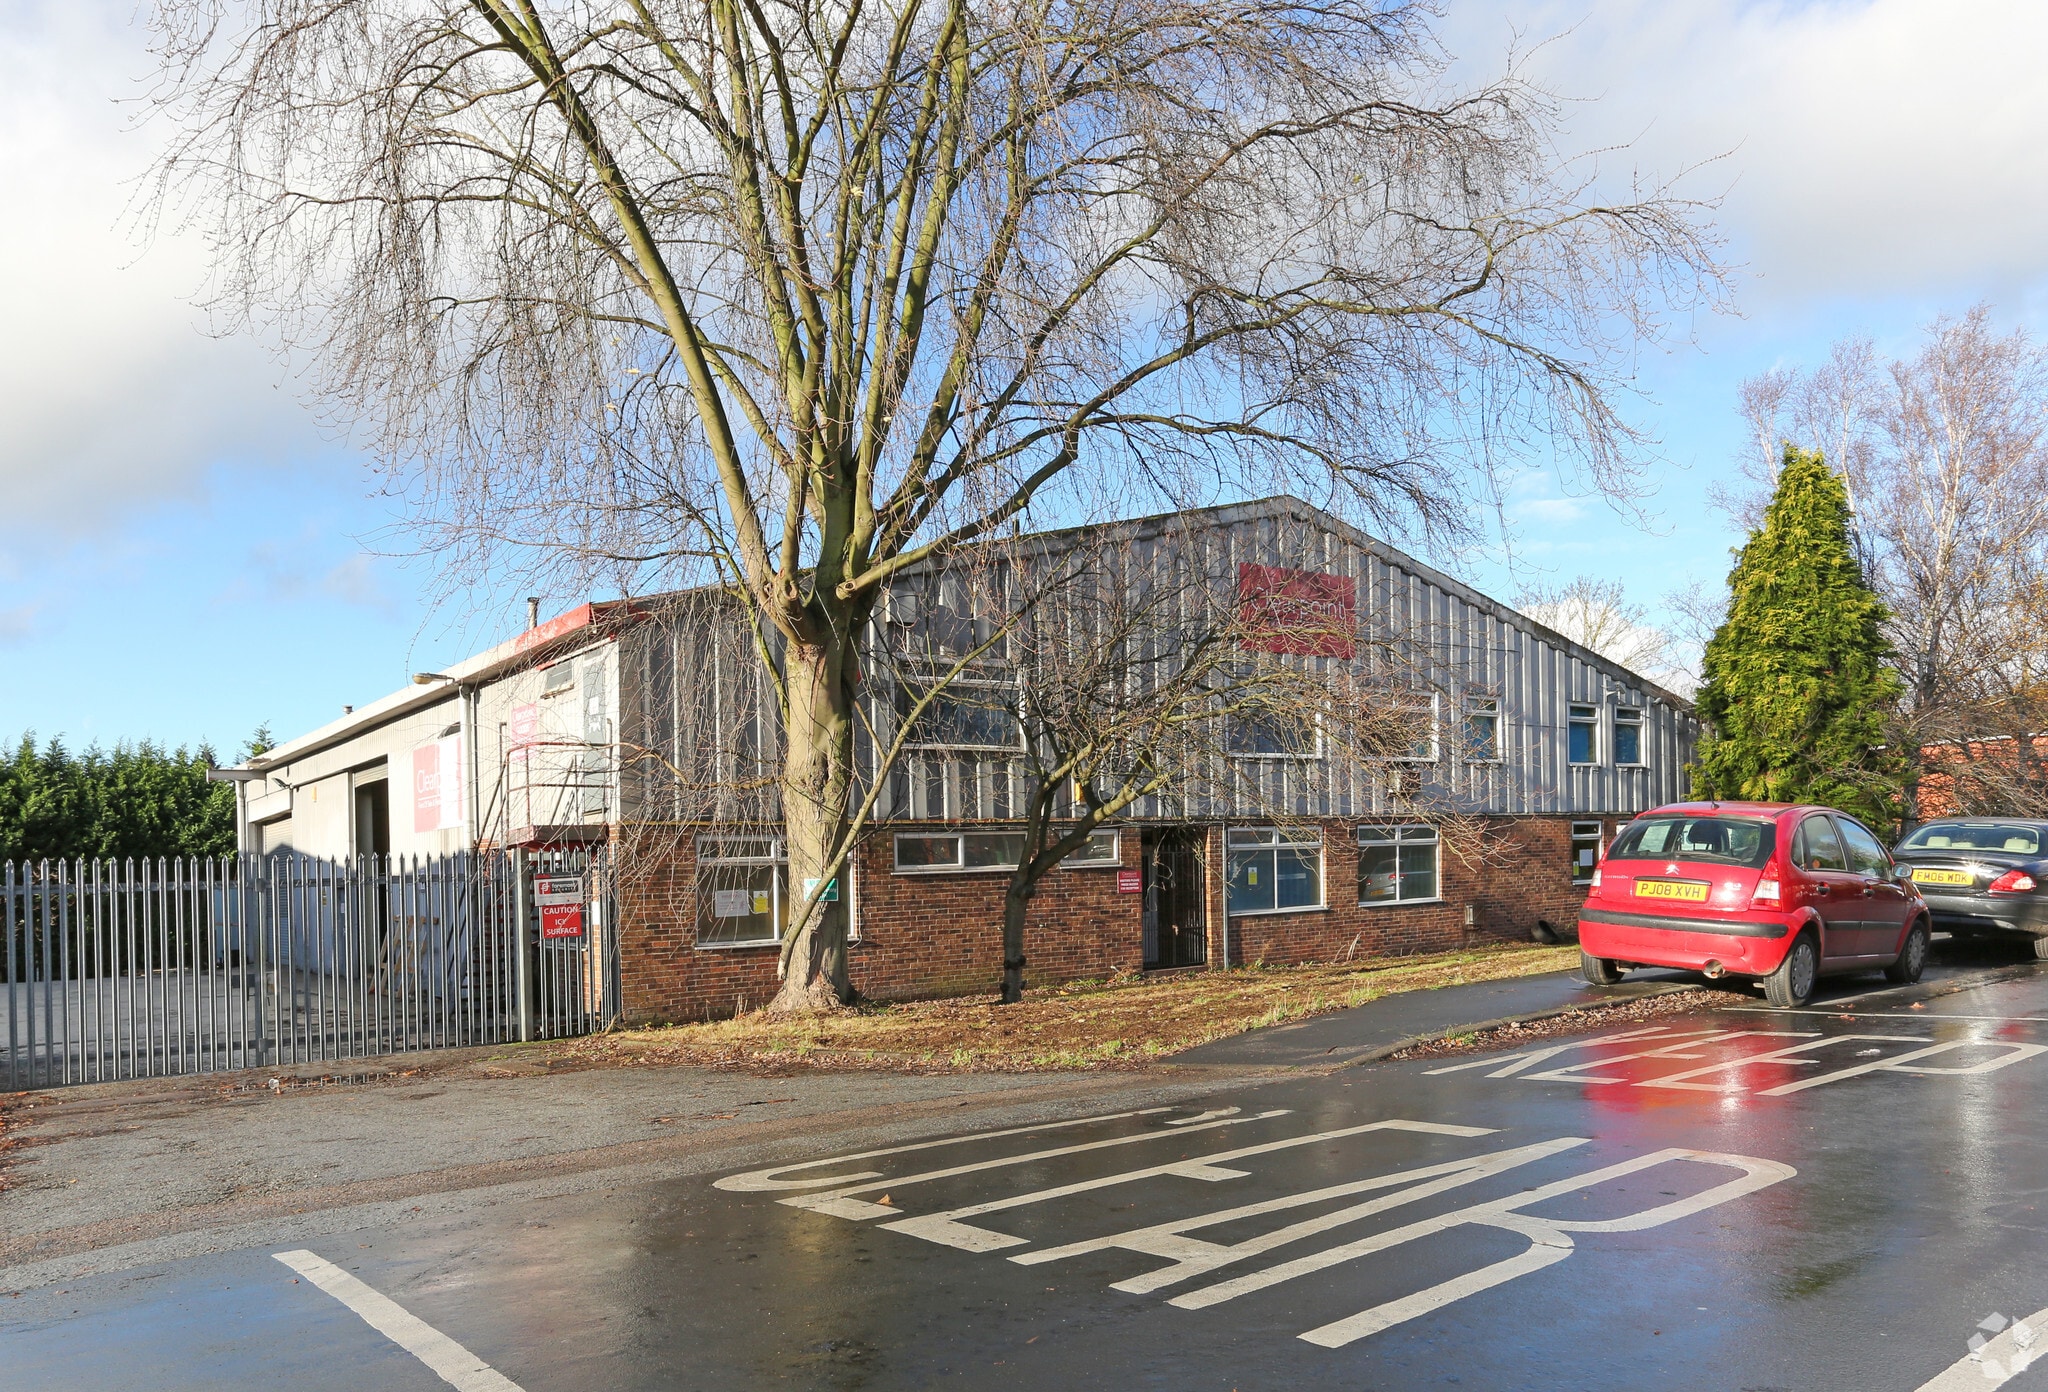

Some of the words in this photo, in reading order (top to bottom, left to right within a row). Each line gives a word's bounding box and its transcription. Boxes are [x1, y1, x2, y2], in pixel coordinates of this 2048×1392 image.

[1916, 871, 1944, 882] FM06
[1640, 883, 1671, 896] PJ08
[1675, 884, 1701, 898] XVH
[544, 906, 579, 915] CAUTION
[546, 926, 578, 936] SURFACE
[1421, 1026, 2048, 1097] KEEP
[712, 1106, 1799, 1349] CLEAR
